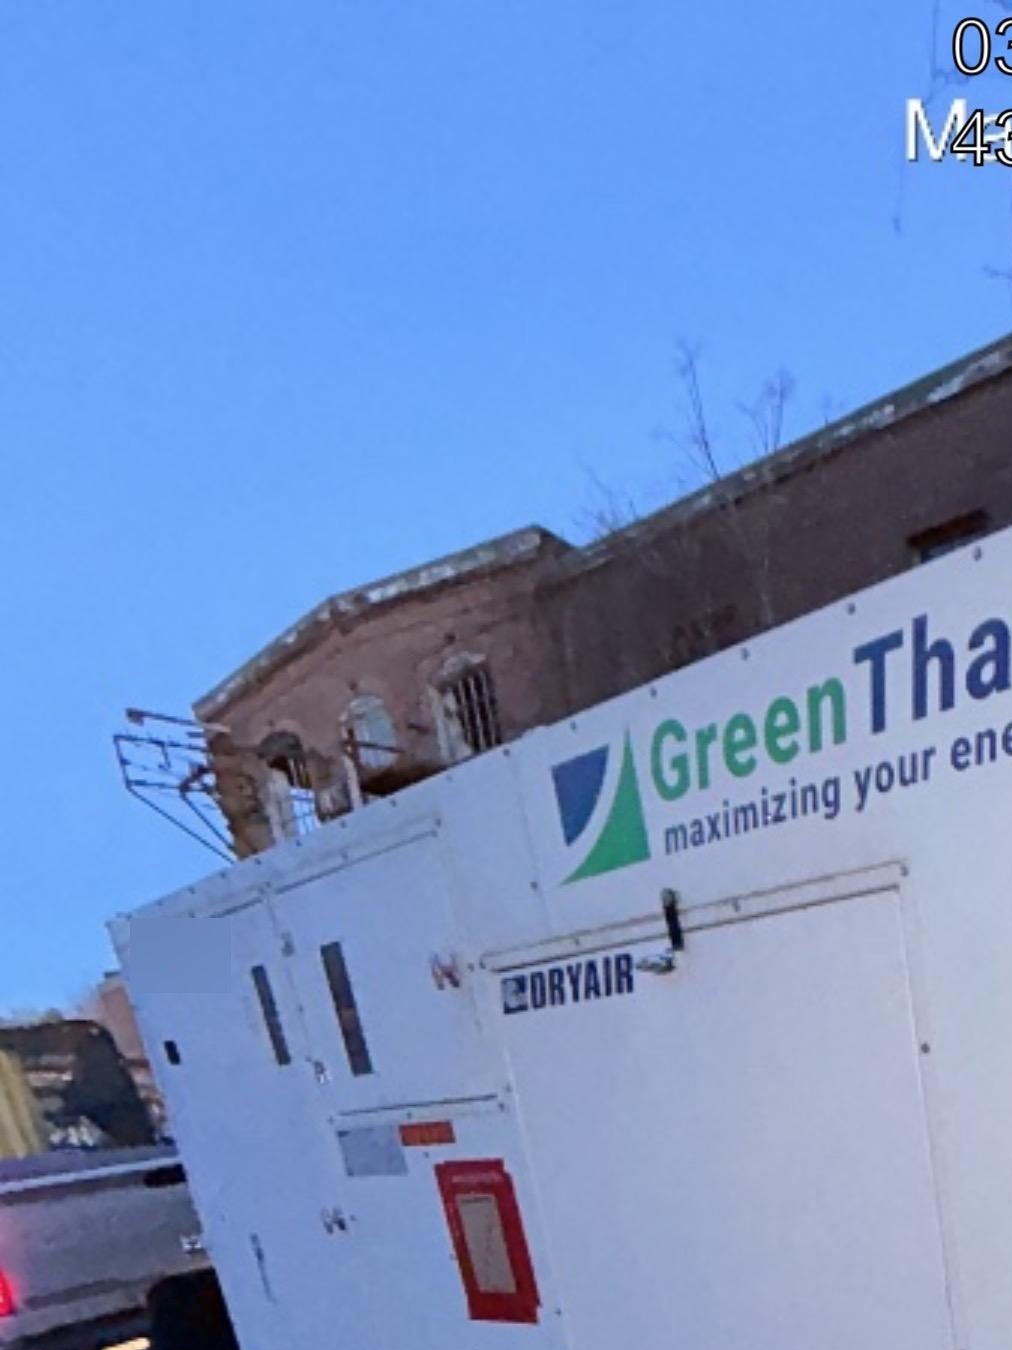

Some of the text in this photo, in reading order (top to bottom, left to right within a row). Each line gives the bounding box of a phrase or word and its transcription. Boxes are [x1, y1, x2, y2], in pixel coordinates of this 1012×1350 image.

[664, 775, 841, 856] maximizing
[853, 747, 937, 811] your
[529, 953, 634, 1011] DRYAIR
